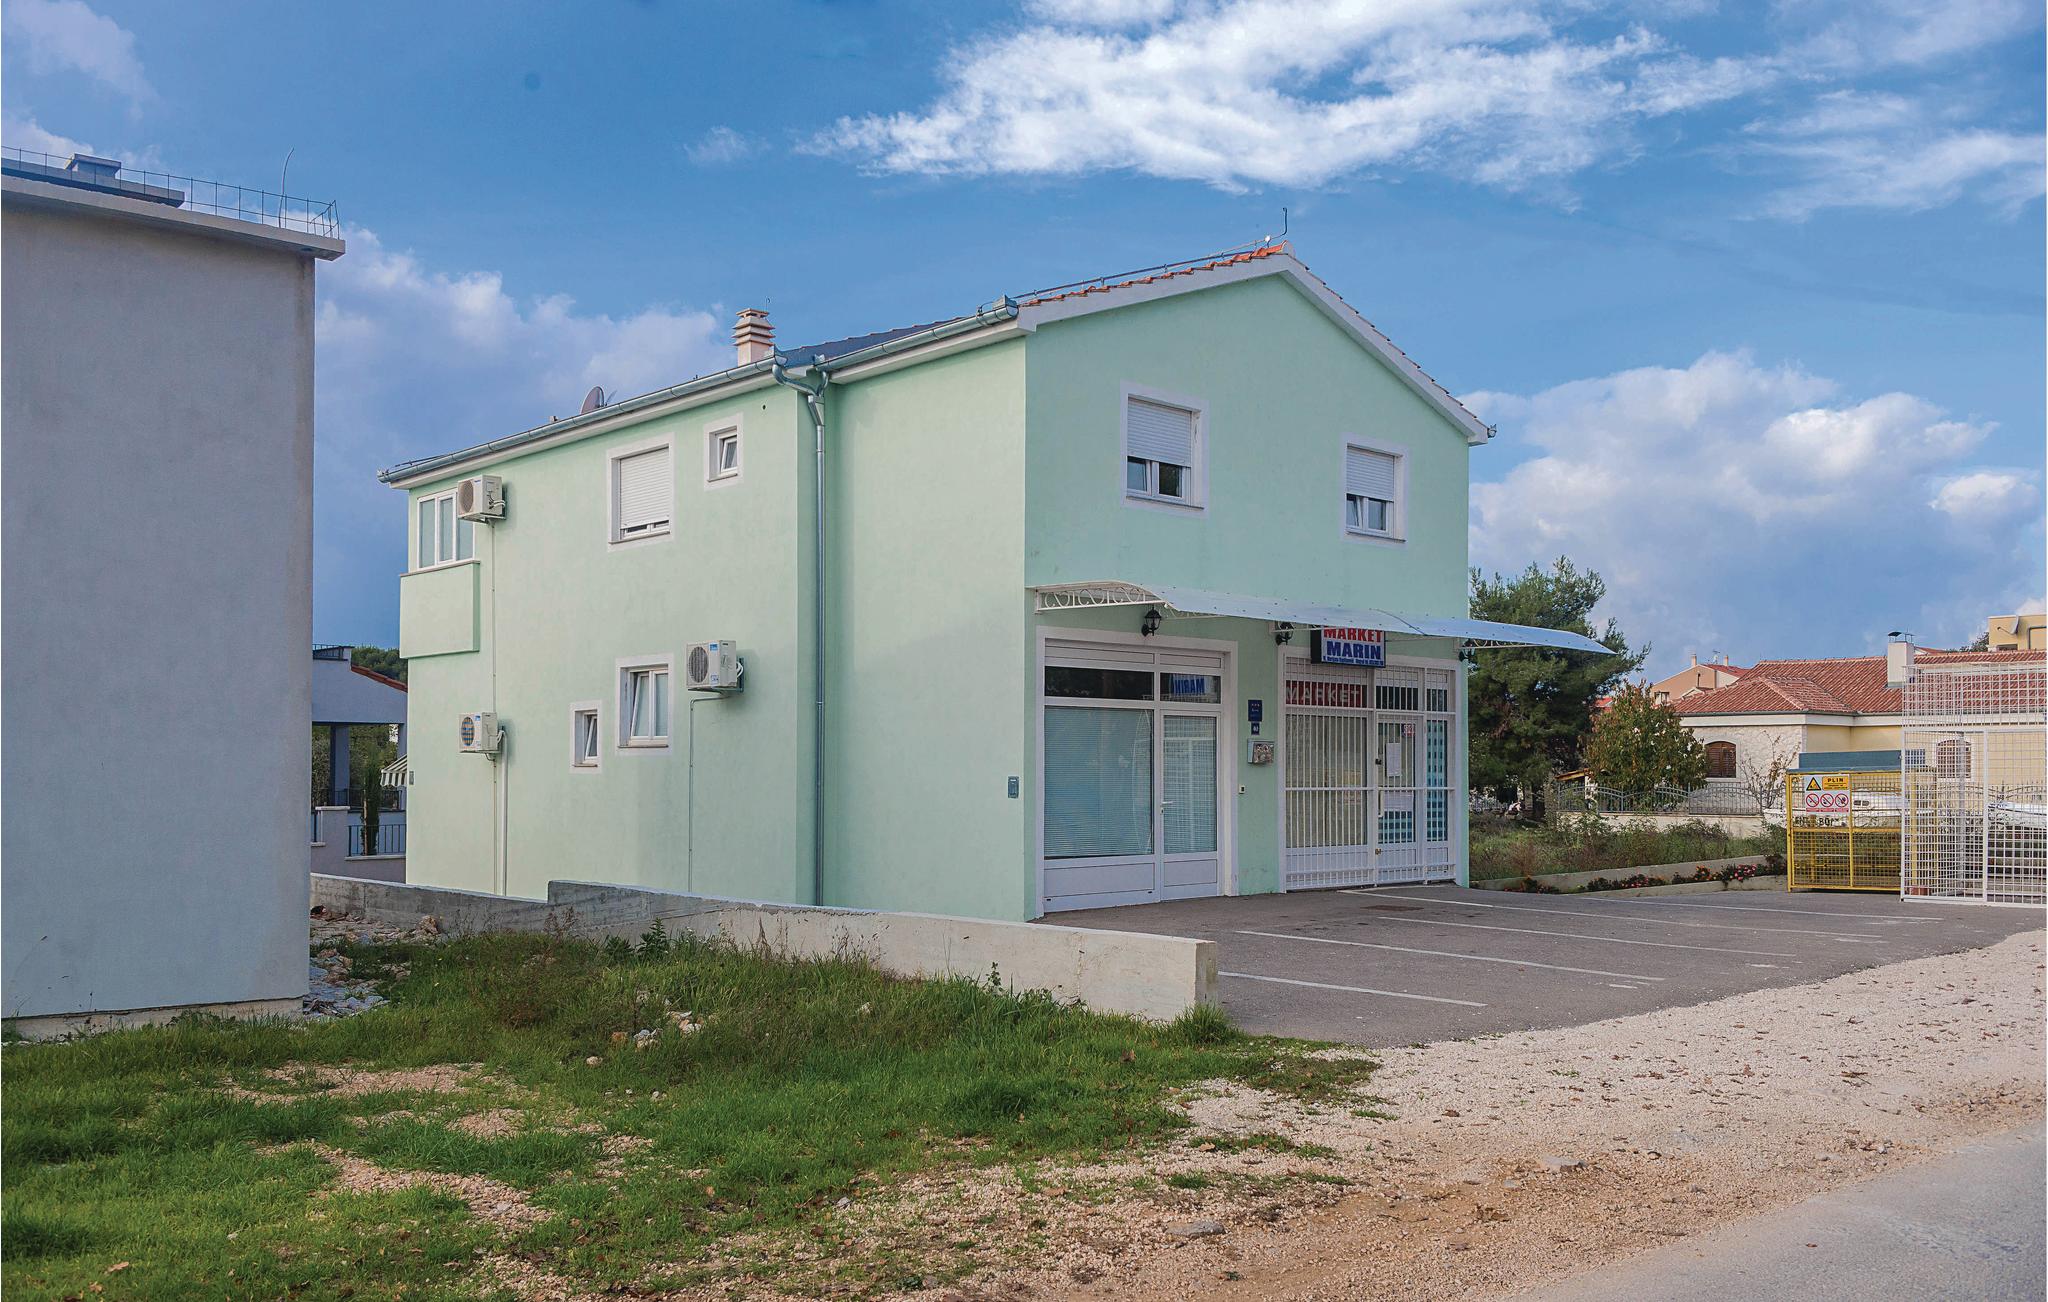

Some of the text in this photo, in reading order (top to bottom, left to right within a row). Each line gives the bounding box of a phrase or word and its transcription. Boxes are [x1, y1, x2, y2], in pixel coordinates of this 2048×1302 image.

[1323, 627, 1381, 642] MARKET
[1326, 640, 1381, 660] MARIN
[1285, 686, 1360, 704] MARKET
